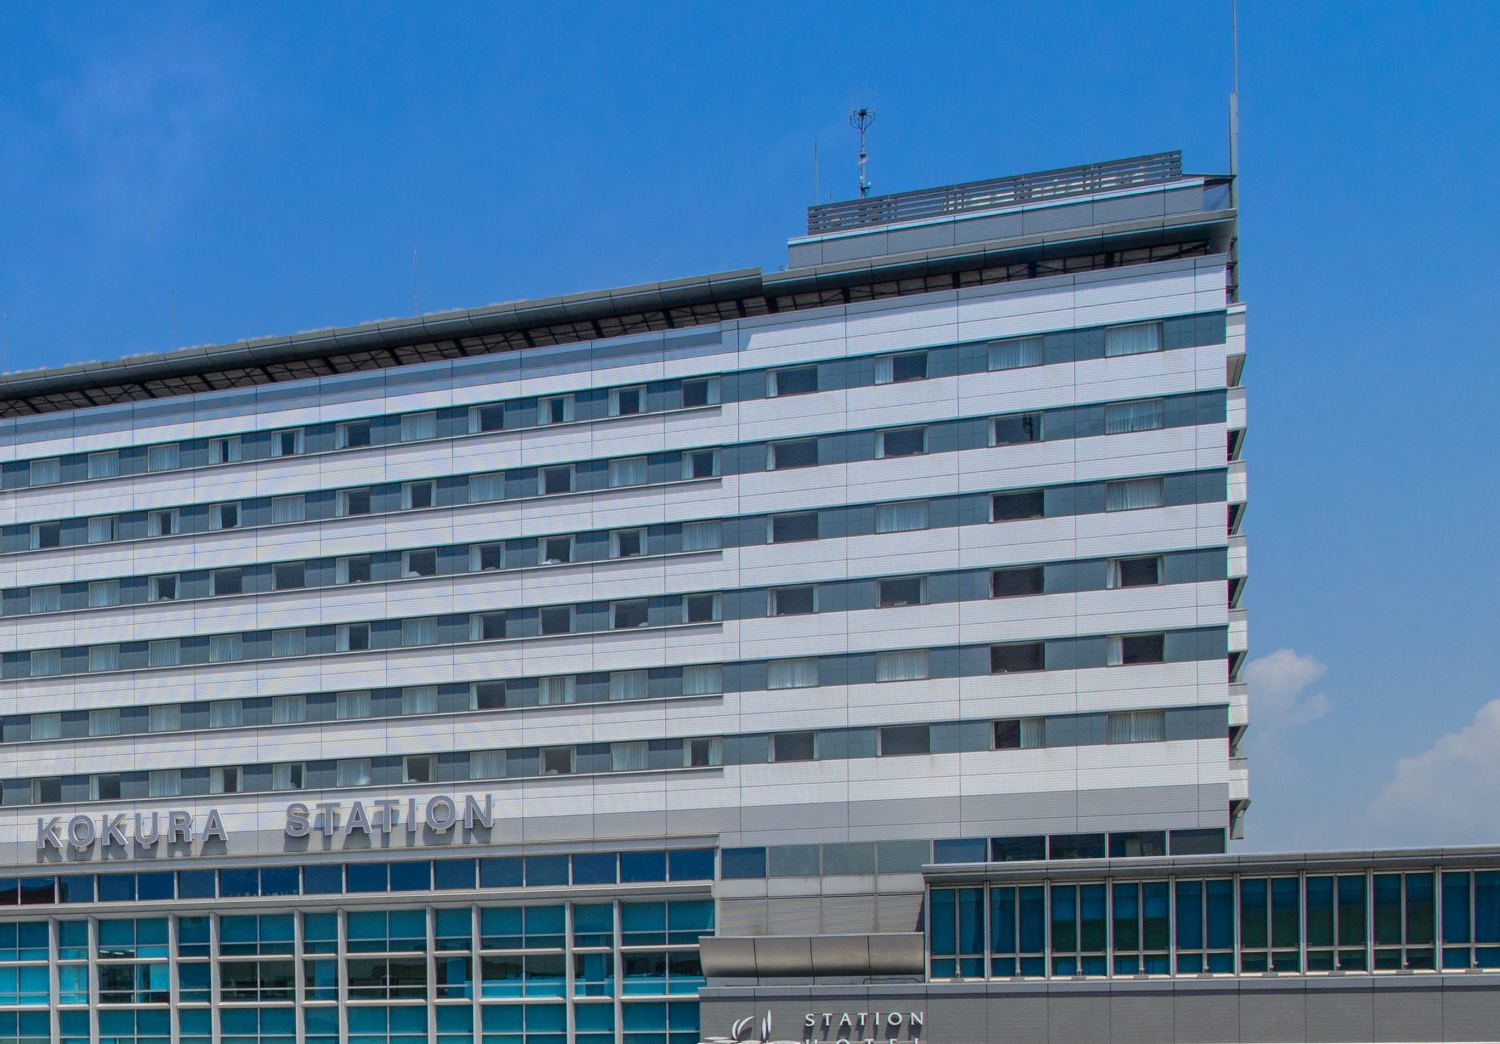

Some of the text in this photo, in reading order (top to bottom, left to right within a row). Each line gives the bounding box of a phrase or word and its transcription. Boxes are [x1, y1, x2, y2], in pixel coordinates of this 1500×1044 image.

[37, 793, 496, 849] KOKURA STATION
[805, 1011, 924, 1027] STATION
